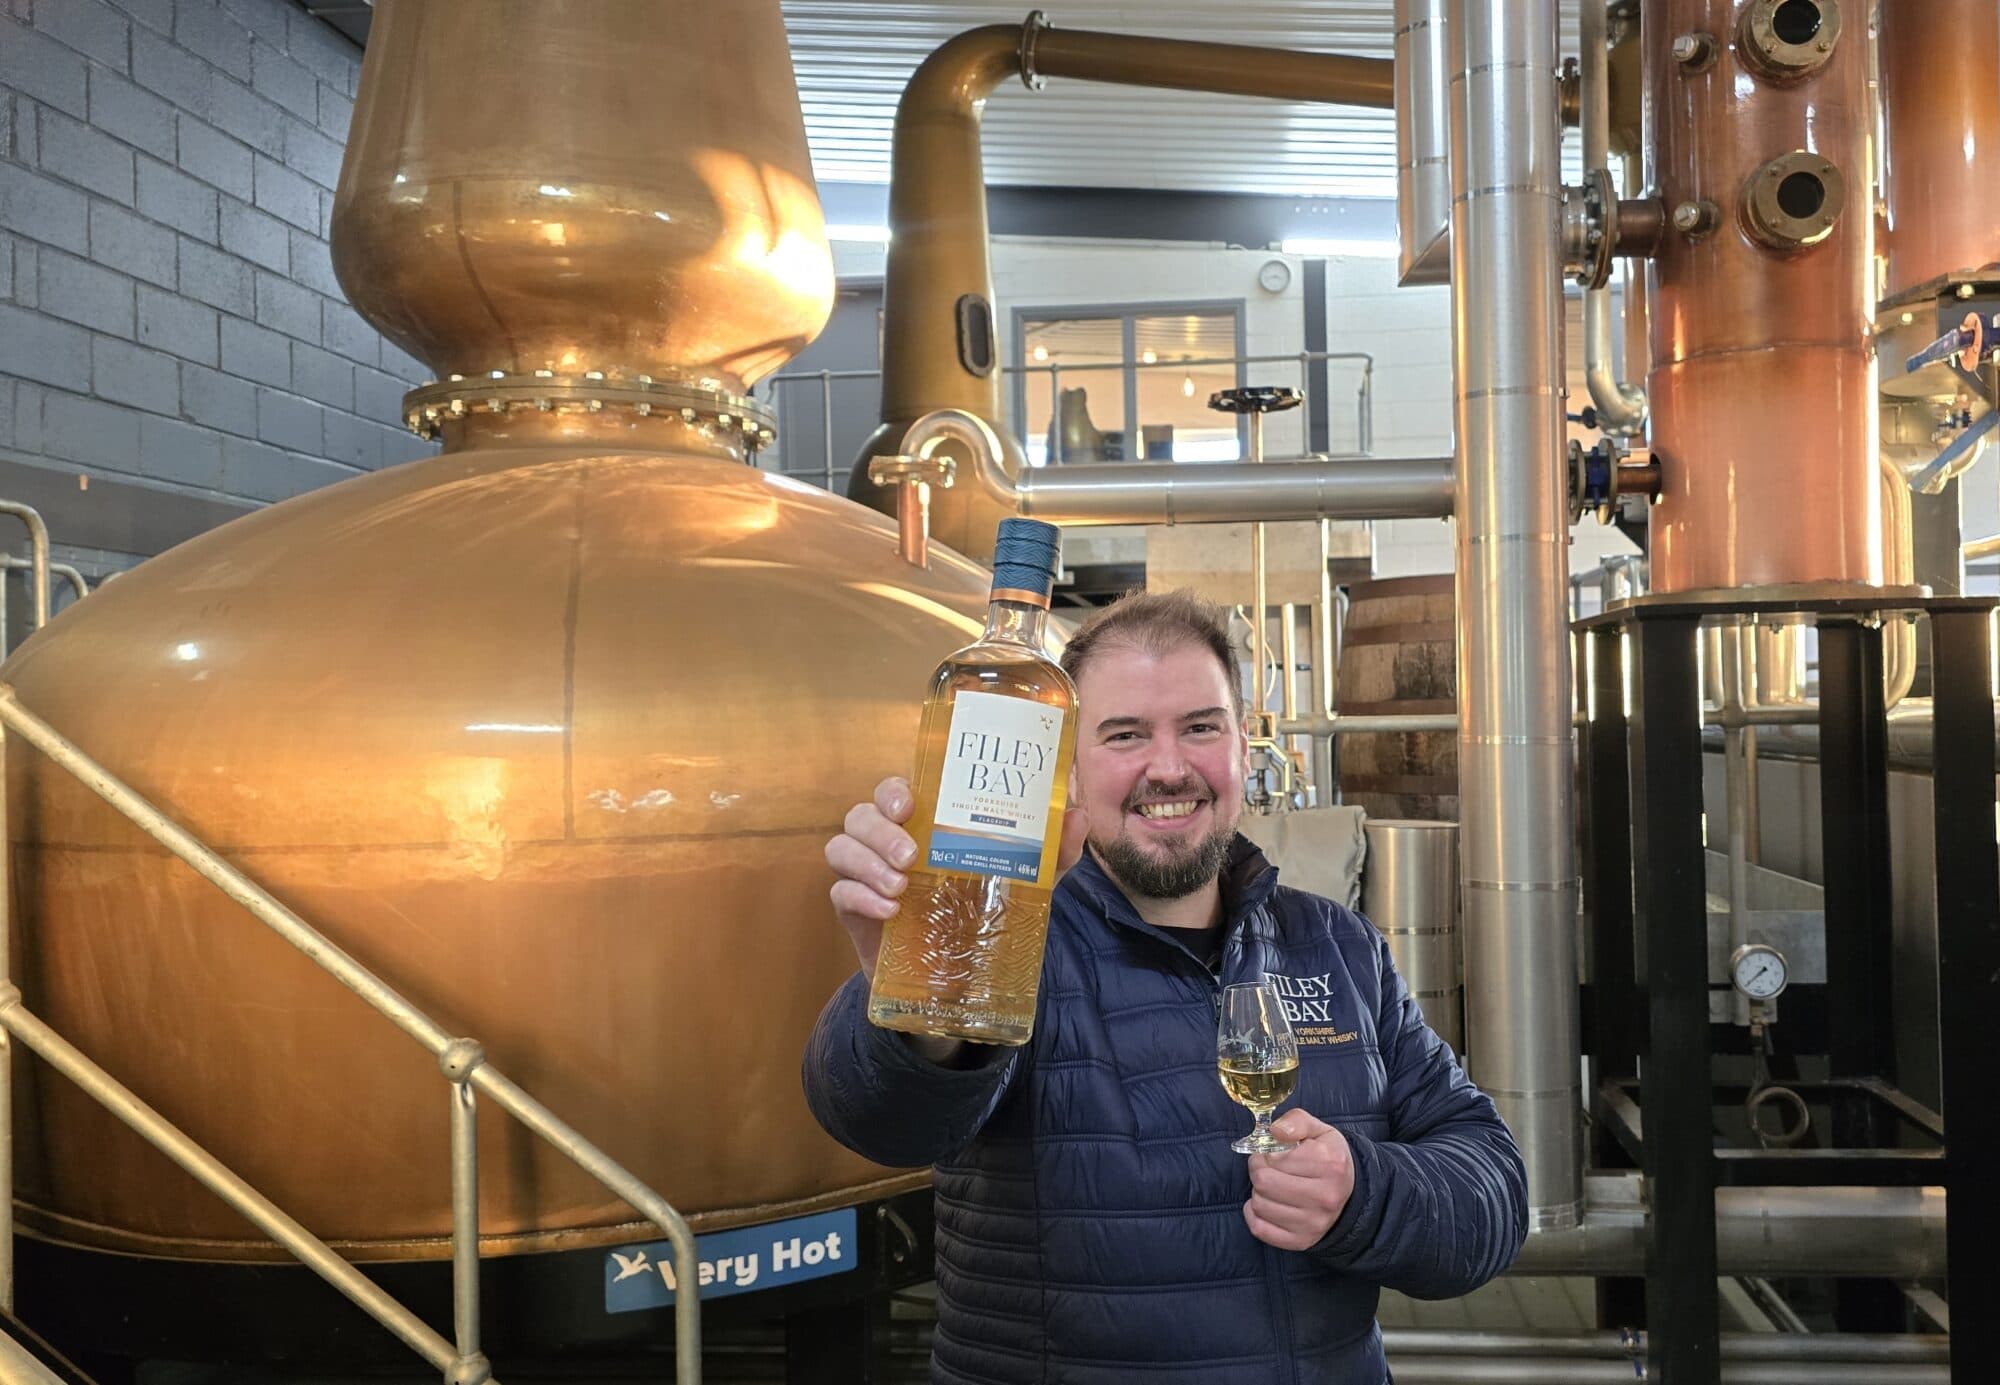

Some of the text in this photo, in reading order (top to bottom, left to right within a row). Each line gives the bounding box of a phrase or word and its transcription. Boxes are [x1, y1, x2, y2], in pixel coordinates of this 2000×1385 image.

[957, 731, 1053, 771] FILEY
[968, 763, 1035, 798] BAY
[951, 802, 1036, 821] SINGLE MALT WHISKY
[974, 796, 1019, 809] YORKSHIRE
[964, 853, 1010, 865] NATURAL COLOUR
[988, 863, 1012, 872] FILTERED
[1263, 971, 1334, 998] FILEY
[1281, 999, 1334, 1022] BAY
[1295, 1026, 1336, 1036] YORKSHIRE
[1305, 1036, 1327, 1045] MALT
[1327, 1030, 1358, 1045] WHISKY
[772, 1231, 842, 1273] Hot
